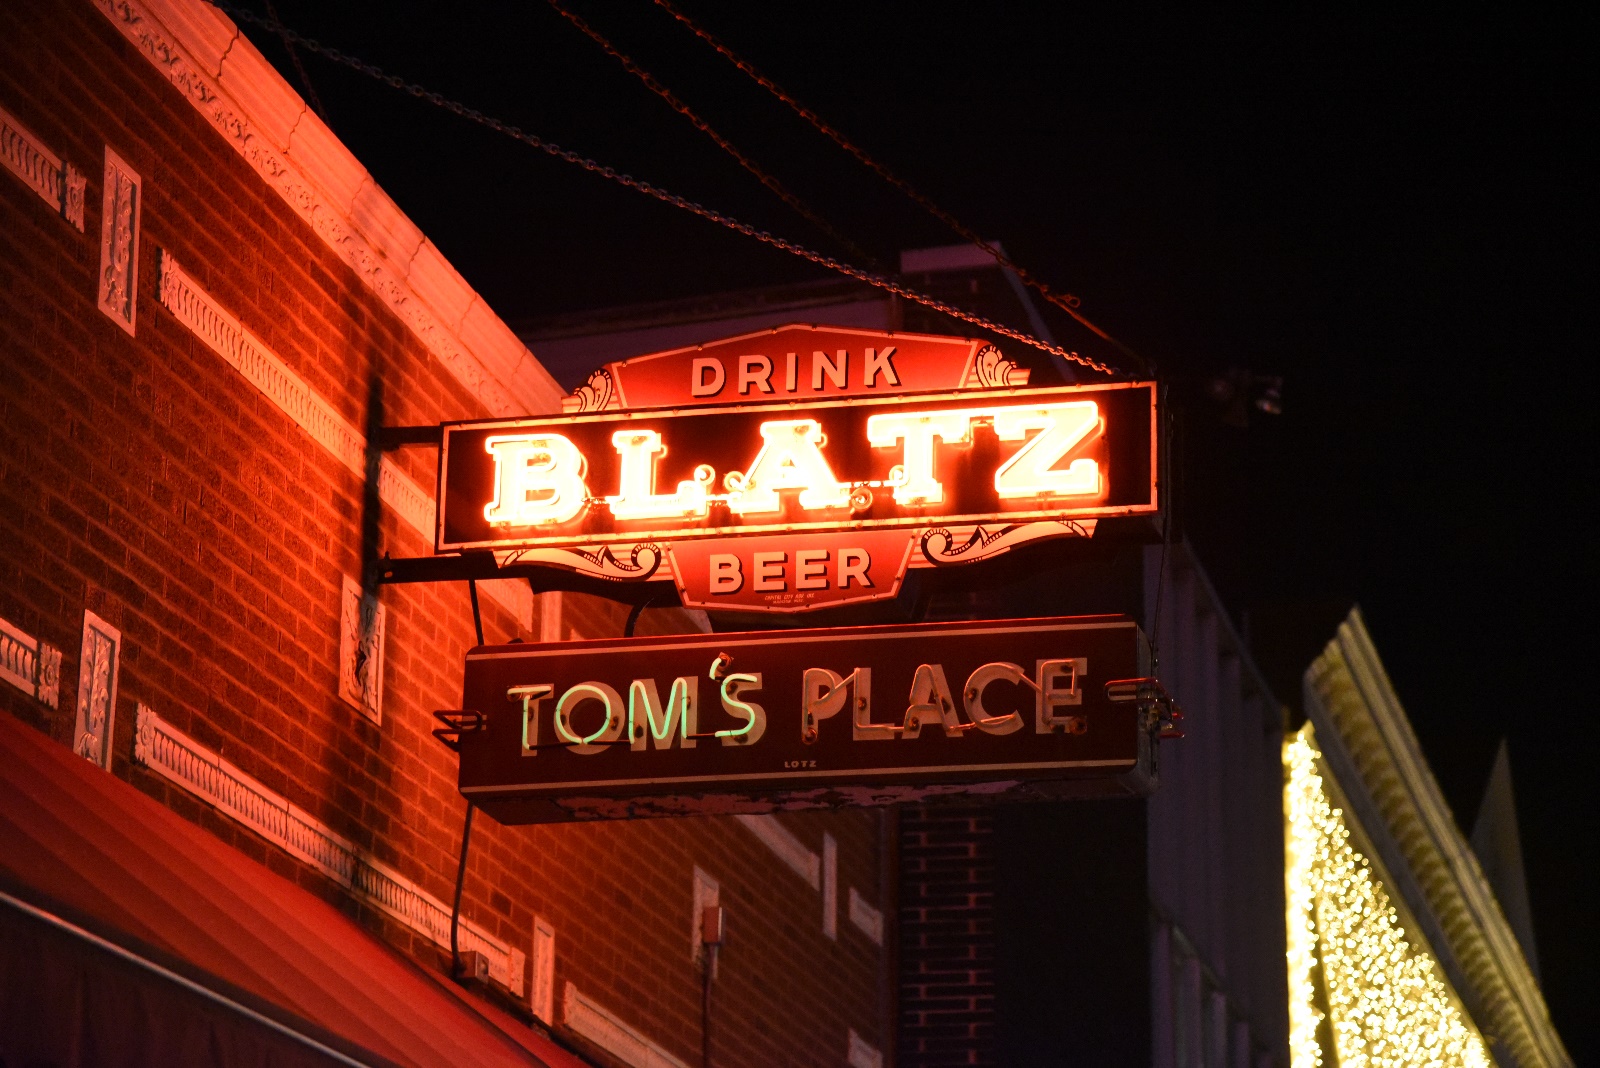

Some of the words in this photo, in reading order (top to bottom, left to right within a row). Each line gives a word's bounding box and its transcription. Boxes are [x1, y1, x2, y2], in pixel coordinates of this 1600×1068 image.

[691, 346, 901, 398] DRINK
[484, 400, 1105, 528] BLATZ
[709, 548, 875, 595] BEER
[507, 652, 767, 757] TOM'S
[803, 657, 1088, 744] PLACE
[784, 760, 817, 769] LOTZ
